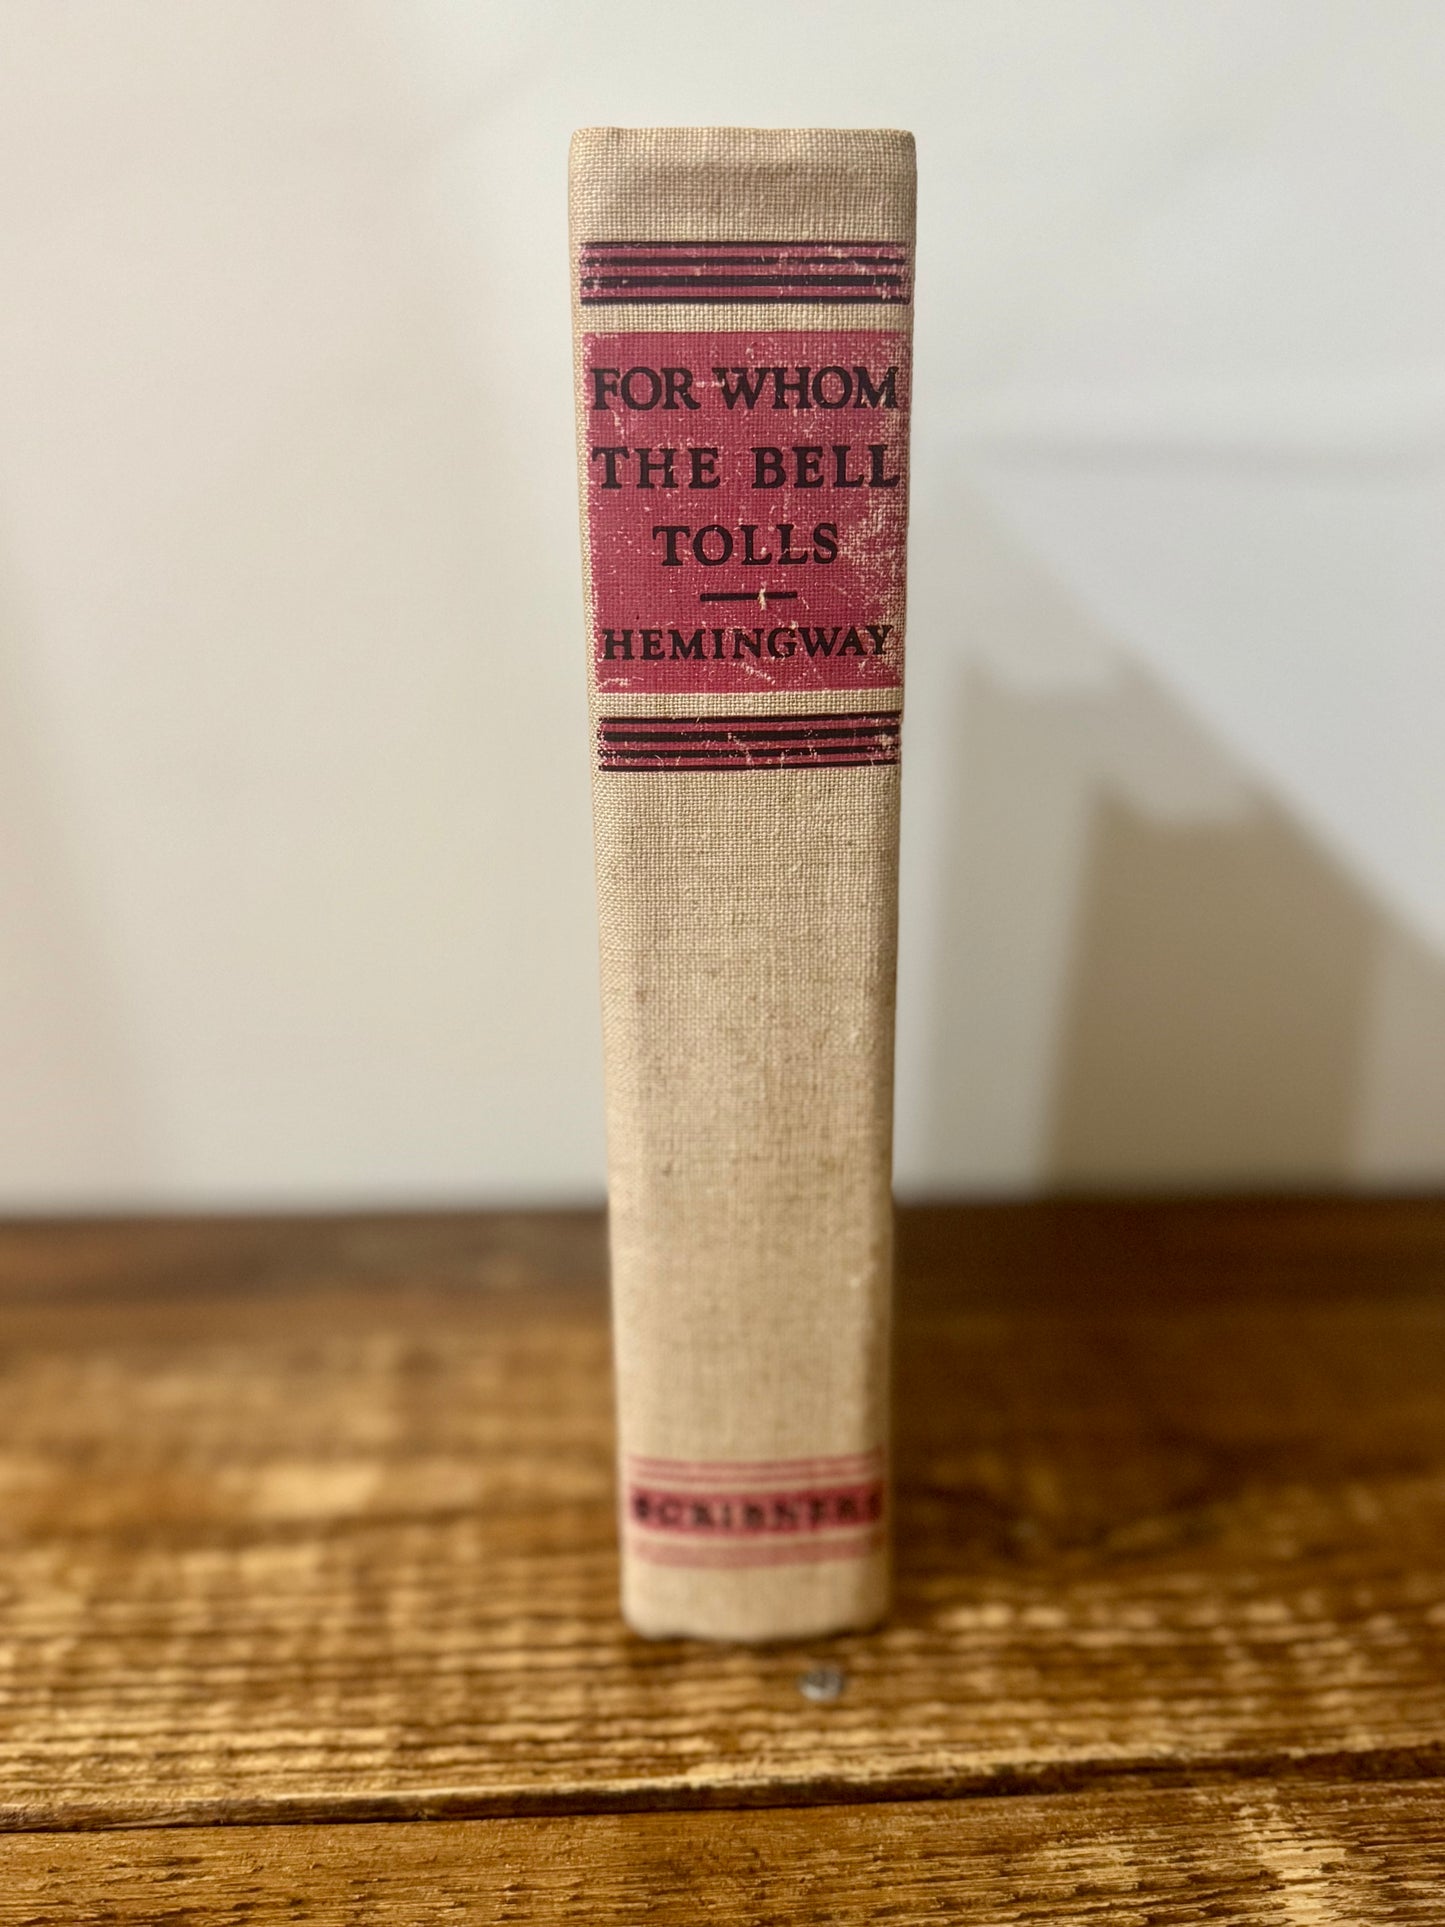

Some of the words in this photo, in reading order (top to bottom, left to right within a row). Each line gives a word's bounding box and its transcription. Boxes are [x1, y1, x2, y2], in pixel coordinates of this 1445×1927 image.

[590, 366, 701, 411] FOR
[712, 365, 900, 410] WHOM
[592, 446, 721, 490] THE
[750, 443, 900, 489] BELL
[652, 522, 839, 567] TOLLS
[602, 624, 894, 661] HEMINGWAY
